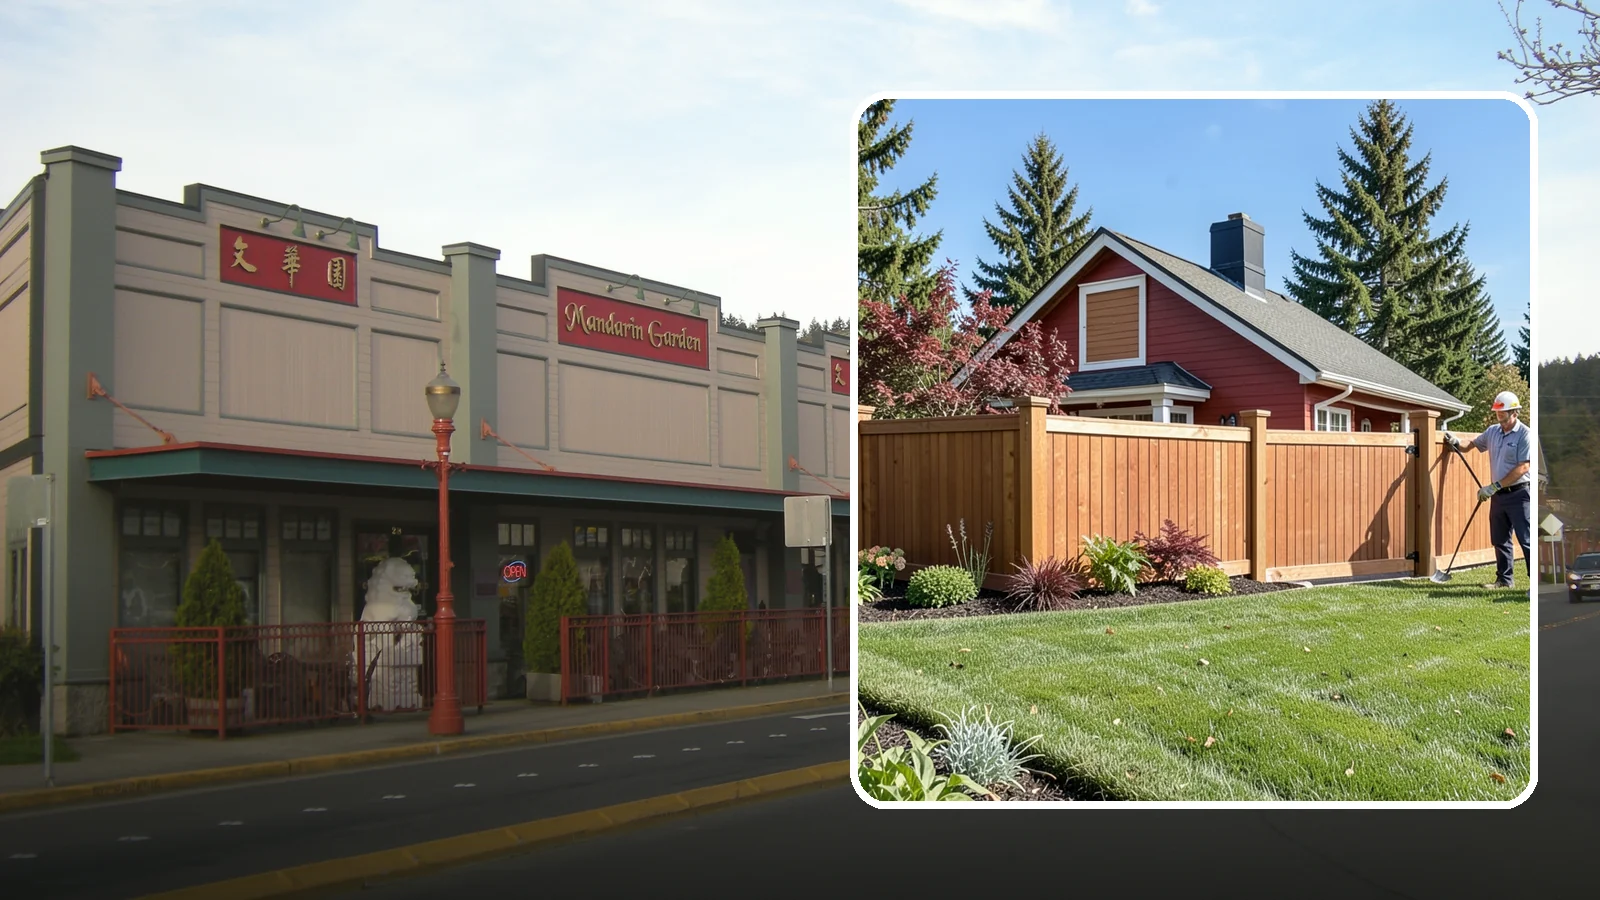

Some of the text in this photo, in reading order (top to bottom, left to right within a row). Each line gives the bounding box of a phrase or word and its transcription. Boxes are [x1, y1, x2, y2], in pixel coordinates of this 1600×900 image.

[231, 235, 346, 291] 文華園
[564, 302, 702, 352] Mandarin Garden
[503, 565, 527, 578] OPEN
